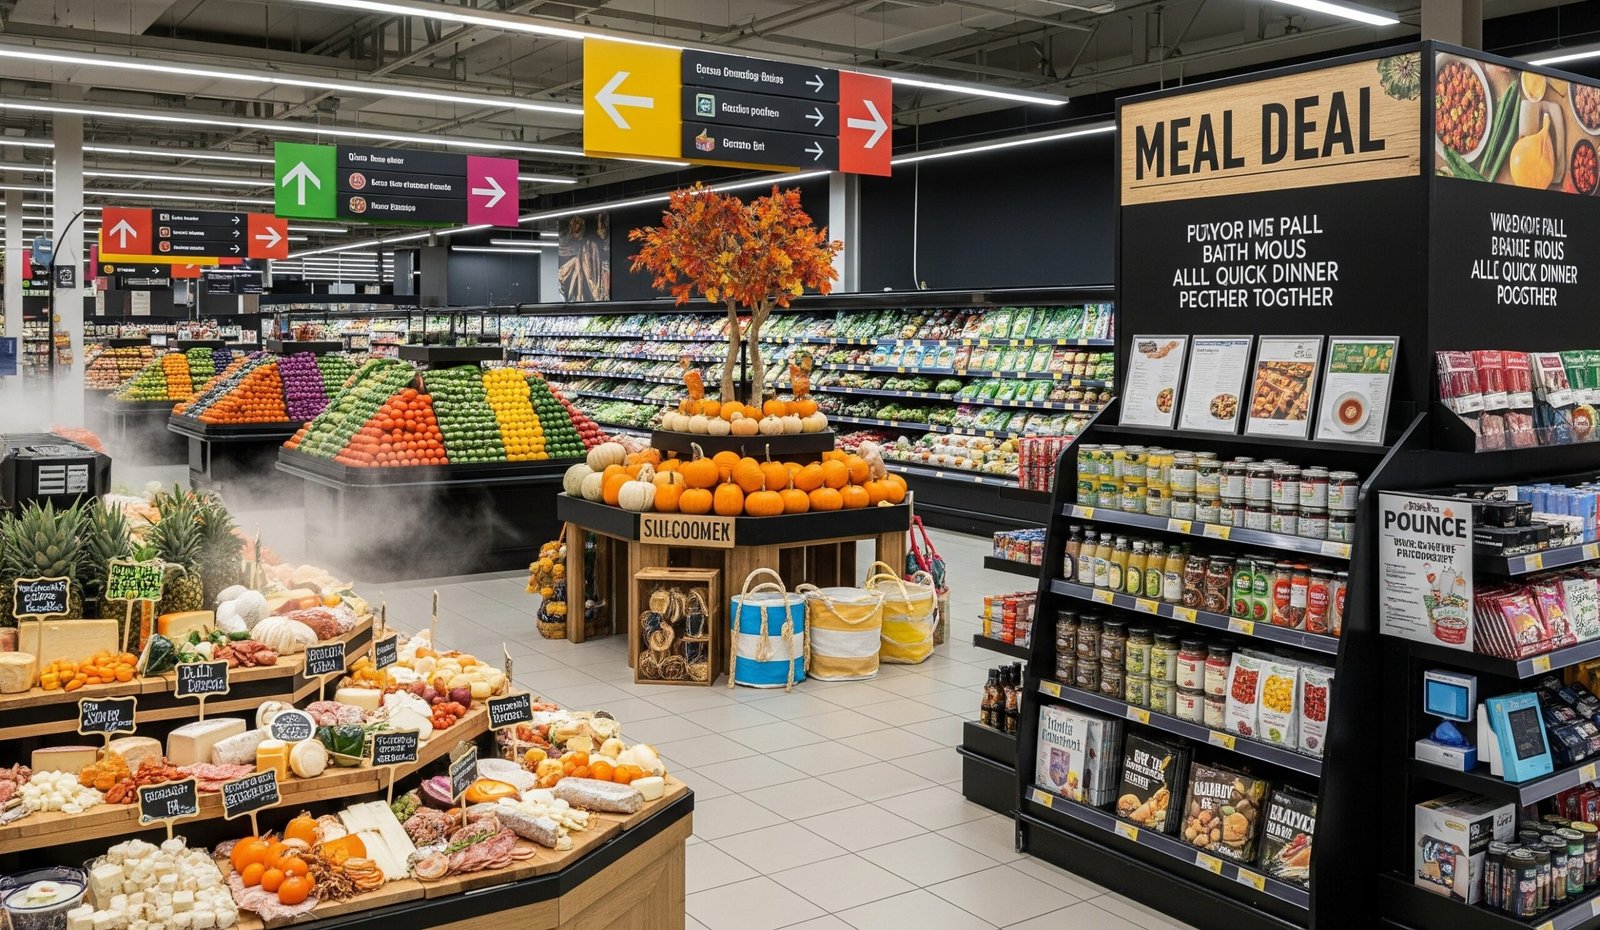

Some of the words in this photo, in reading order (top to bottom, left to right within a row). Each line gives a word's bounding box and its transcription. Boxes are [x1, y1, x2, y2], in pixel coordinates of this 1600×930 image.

[1135, 109, 1245, 180] MEAL
[1262, 86, 1385, 165] DEAL
[1280, 214, 1323, 236] PALL
[1255, 238, 1307, 260] MOUS
[1216, 264, 1267, 288] QUICK
[1272, 260, 1339, 284] DINNER
[1502, 261, 1537, 282] QUICK
[1540, 263, 1578, 284] DINNER
[1179, 289, 1249, 309] PECTHER
[1253, 286, 1333, 307] TOGTHER
[1384, 509, 1467, 539] POUNCE
